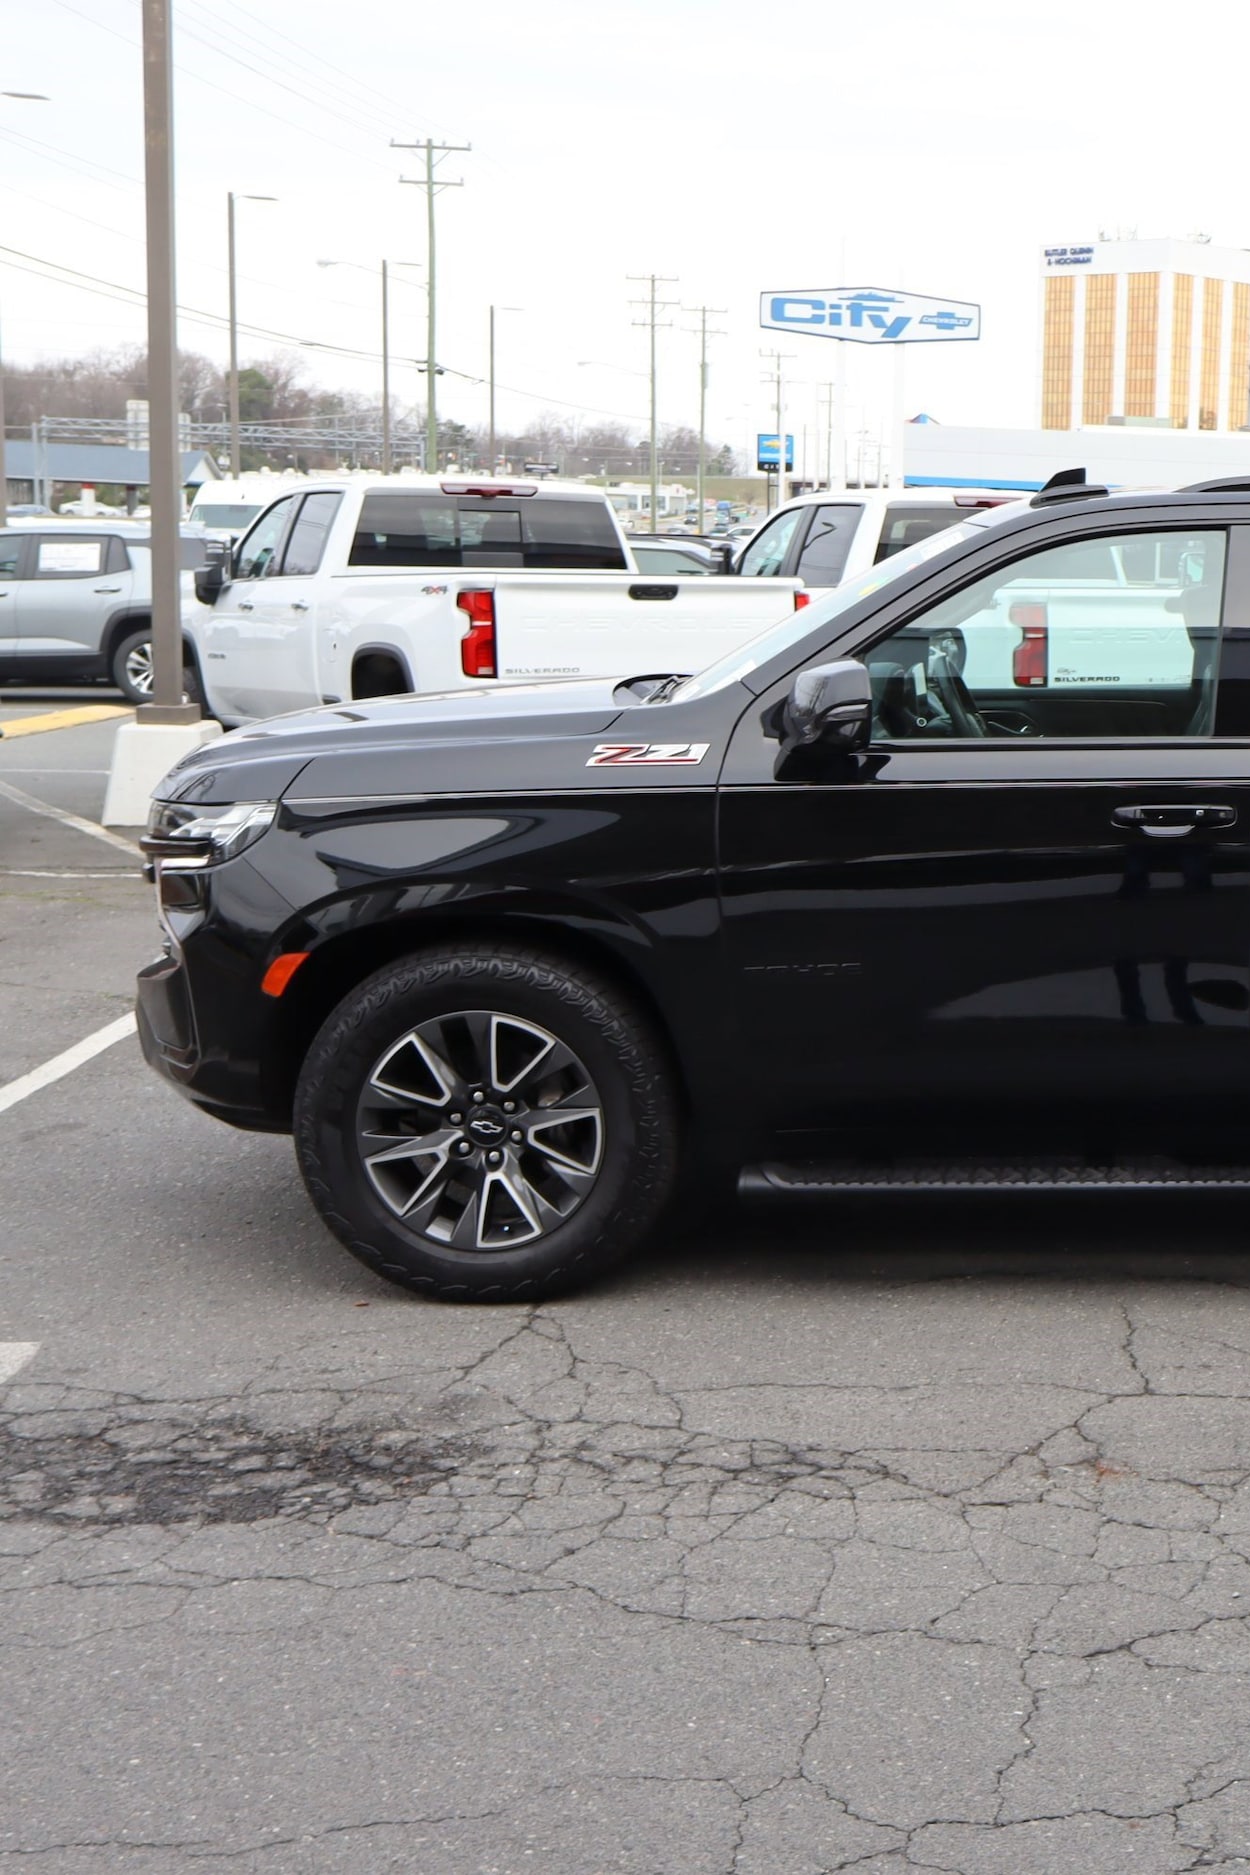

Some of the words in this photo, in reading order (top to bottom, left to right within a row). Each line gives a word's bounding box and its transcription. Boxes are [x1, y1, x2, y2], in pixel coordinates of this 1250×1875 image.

[771, 297, 912, 338] City
[1054, 675, 1121, 683] SILVERADO
[585, 744, 710, 767] Z71
